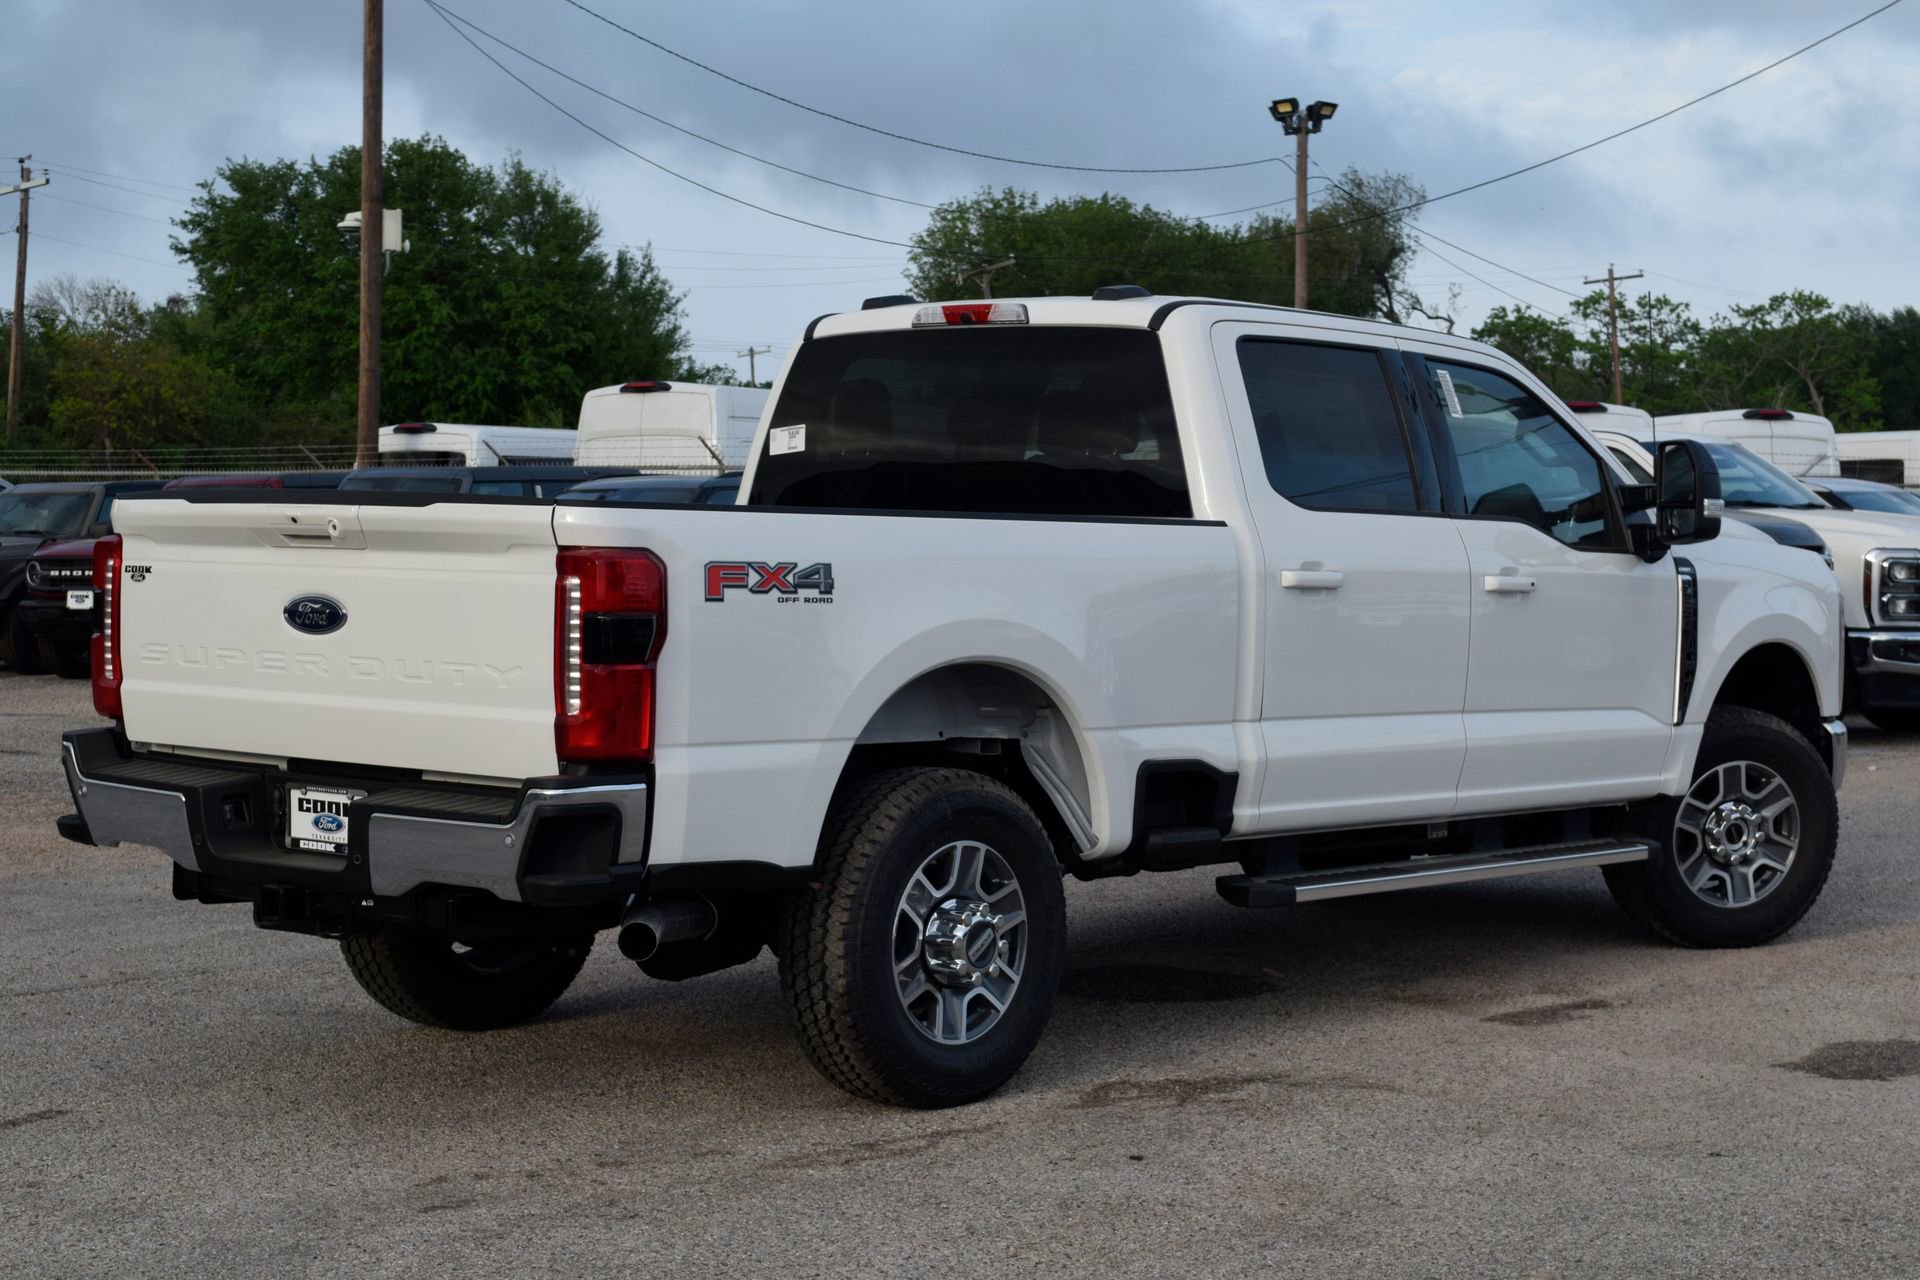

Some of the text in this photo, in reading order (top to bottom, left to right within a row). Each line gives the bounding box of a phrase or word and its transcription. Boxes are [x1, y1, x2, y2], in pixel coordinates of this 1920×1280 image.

[124, 565, 152, 574] COOK
[704, 561, 834, 602] FX4
[777, 596, 833, 604] OFF ROAD
[295, 601, 331, 625] Ford
[139, 642, 525, 689] SUPER DUTY
[318, 816, 338, 830] Ford
[299, 840, 336, 852] COOK
